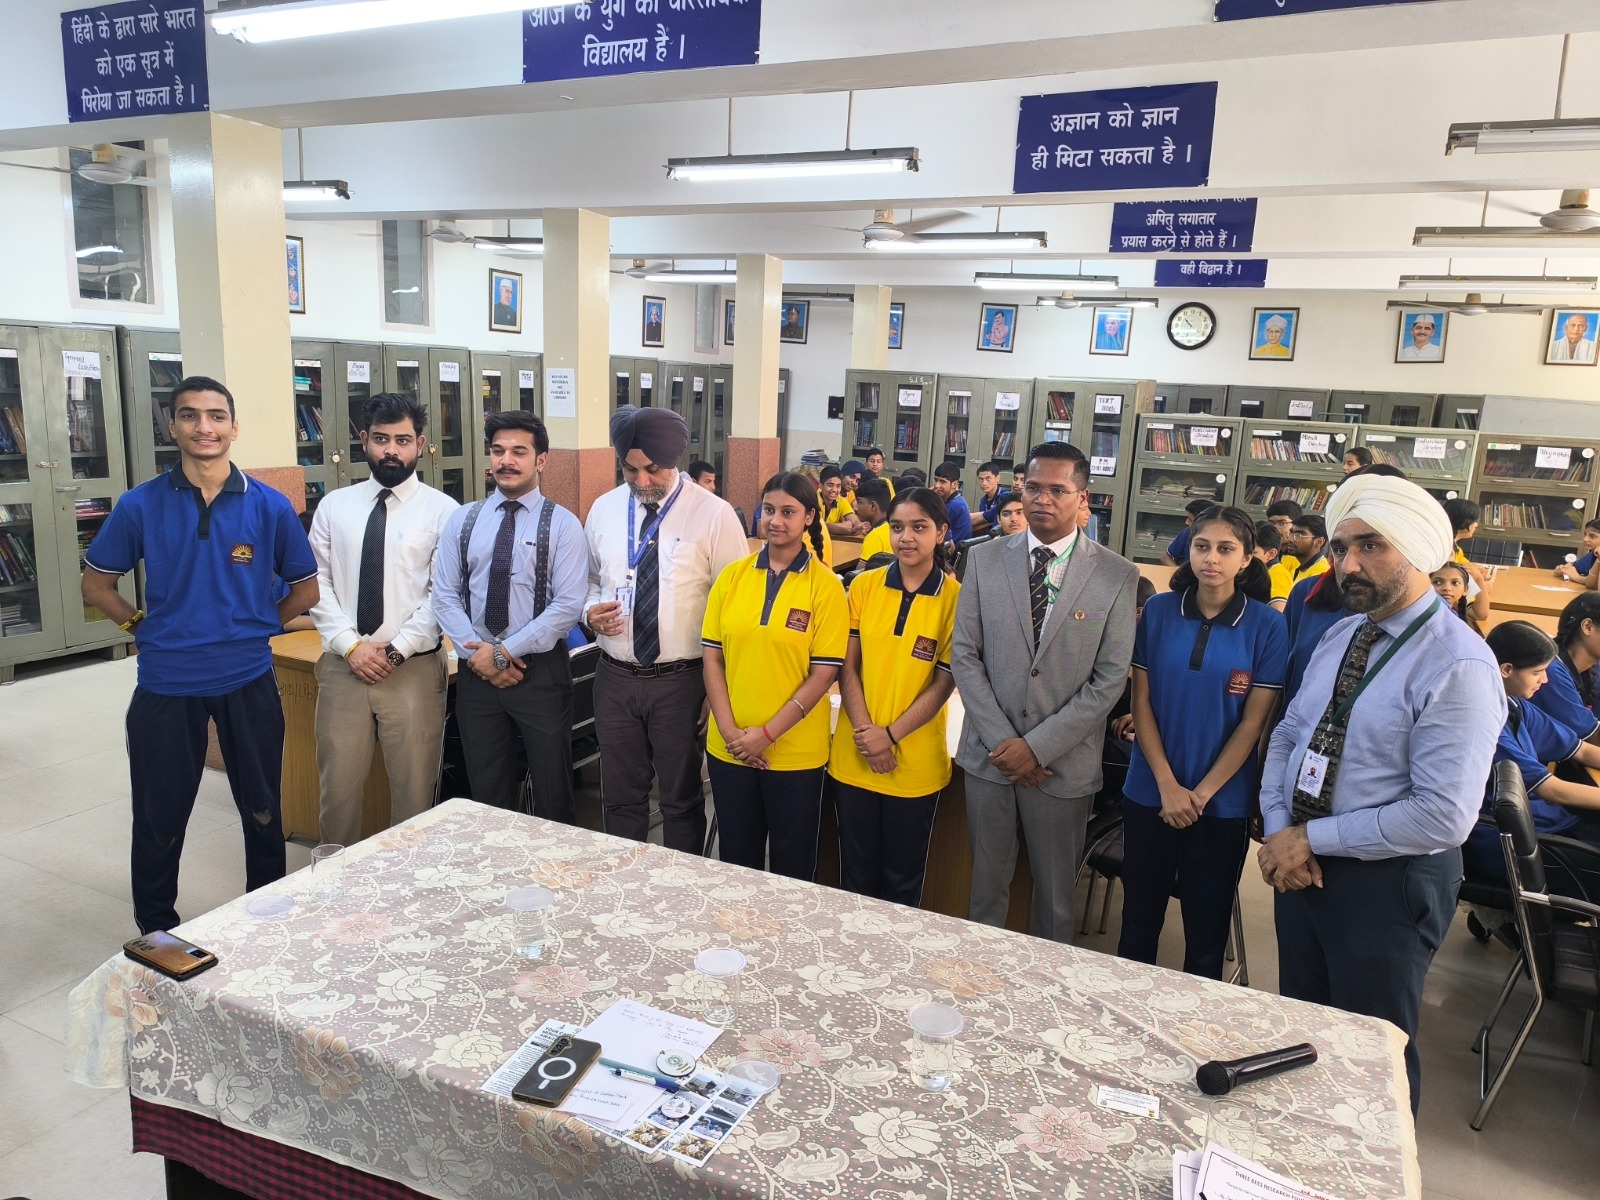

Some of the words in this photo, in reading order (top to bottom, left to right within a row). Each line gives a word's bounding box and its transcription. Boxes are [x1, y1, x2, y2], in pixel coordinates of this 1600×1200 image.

[71, 15, 94, 44] हिंदी
[96, 12, 110, 39] के
[113, 16, 136, 40] द्वारा
[138, 4, 160, 34] सारे
[164, 8, 196, 30] भारत
[96, 49, 112, 76] को
[115, 54, 136, 78] एक
[140, 51, 160, 78] सूत्र
[163, 41, 174, 68] में
[582, 34, 648, 67] विद्यालय
[81, 86, 112, 113] पिरोया
[115, 91, 132, 110] जा
[135, 87, 170, 108] सकता
[174, 75, 184, 105] है
[1050, 112, 1100, 134] अज्ञान
[1107, 102, 1134, 129] को
[1141, 106, 1180, 130] ज्ञान
[1030, 145, 1049, 171] ही
[1055, 144, 1094, 169] मिटा
[1099, 146, 1154, 167] सकता
[1161, 136, 1176, 165] है
[1146, 209, 1174, 231] अपितु
[1178, 212, 1217, 226] लगातार
[1121, 235, 1147, 248] प्रयास
[1151, 230, 1177, 248] करने
[1180, 230, 1190, 248] से
[1194, 230, 1214, 248] होते
[1180, 260, 1196, 275] वही
[1198, 260, 1224, 276] विद्वान
